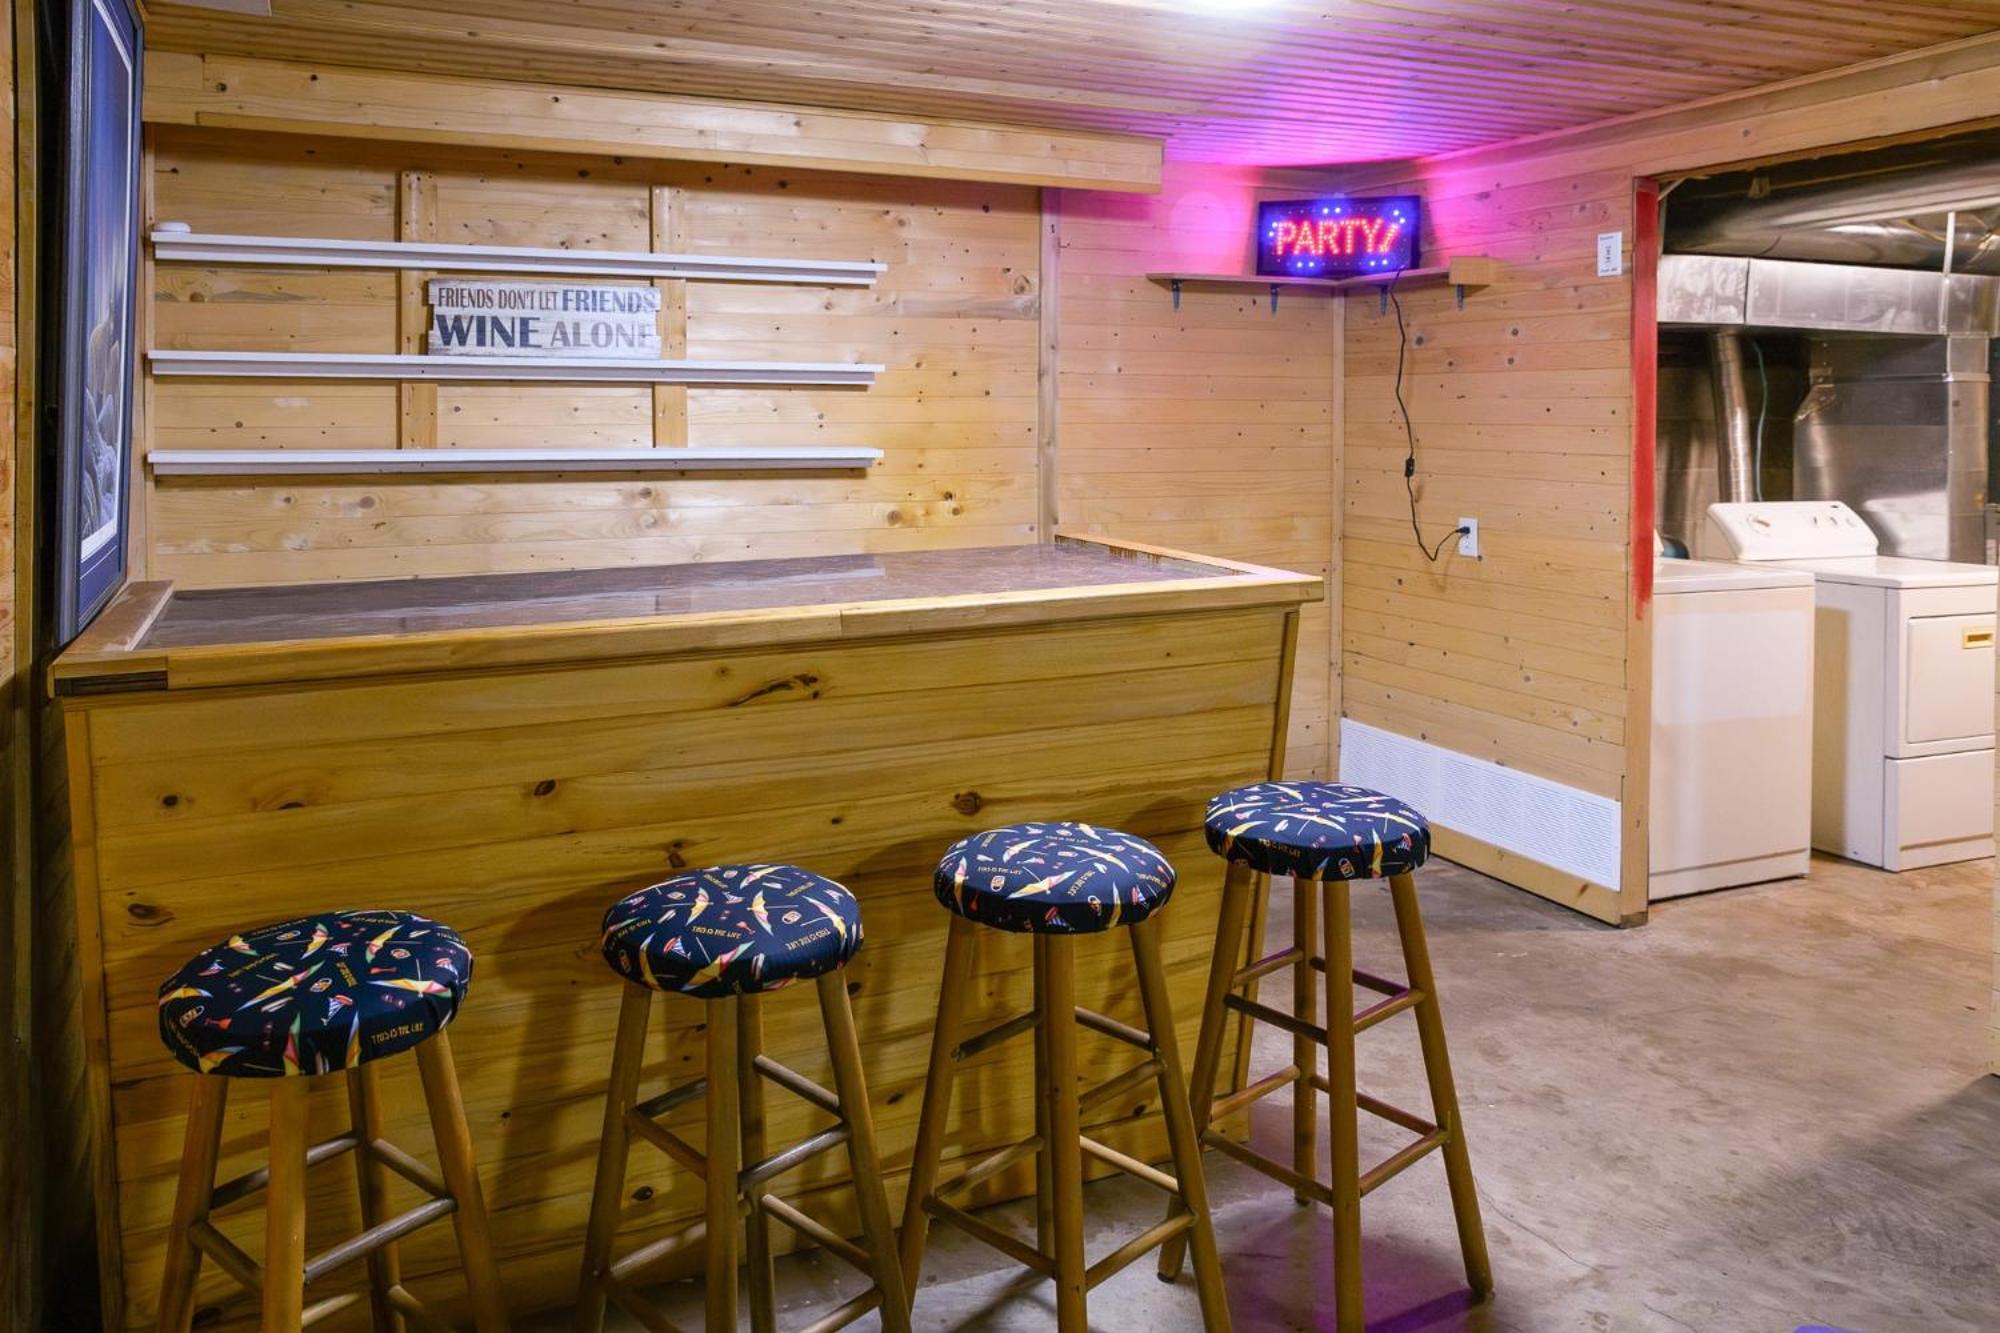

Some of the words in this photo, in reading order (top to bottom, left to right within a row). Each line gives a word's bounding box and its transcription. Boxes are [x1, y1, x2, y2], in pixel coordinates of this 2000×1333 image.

[438, 287, 494, 309] FRIENDS
[498, 288, 536, 310] DON'T
[540, 290, 560, 311] LET
[562, 288, 656, 313] FRIENDS
[436, 314, 543, 348] WINE
[550, 321, 656, 348] ALONE
